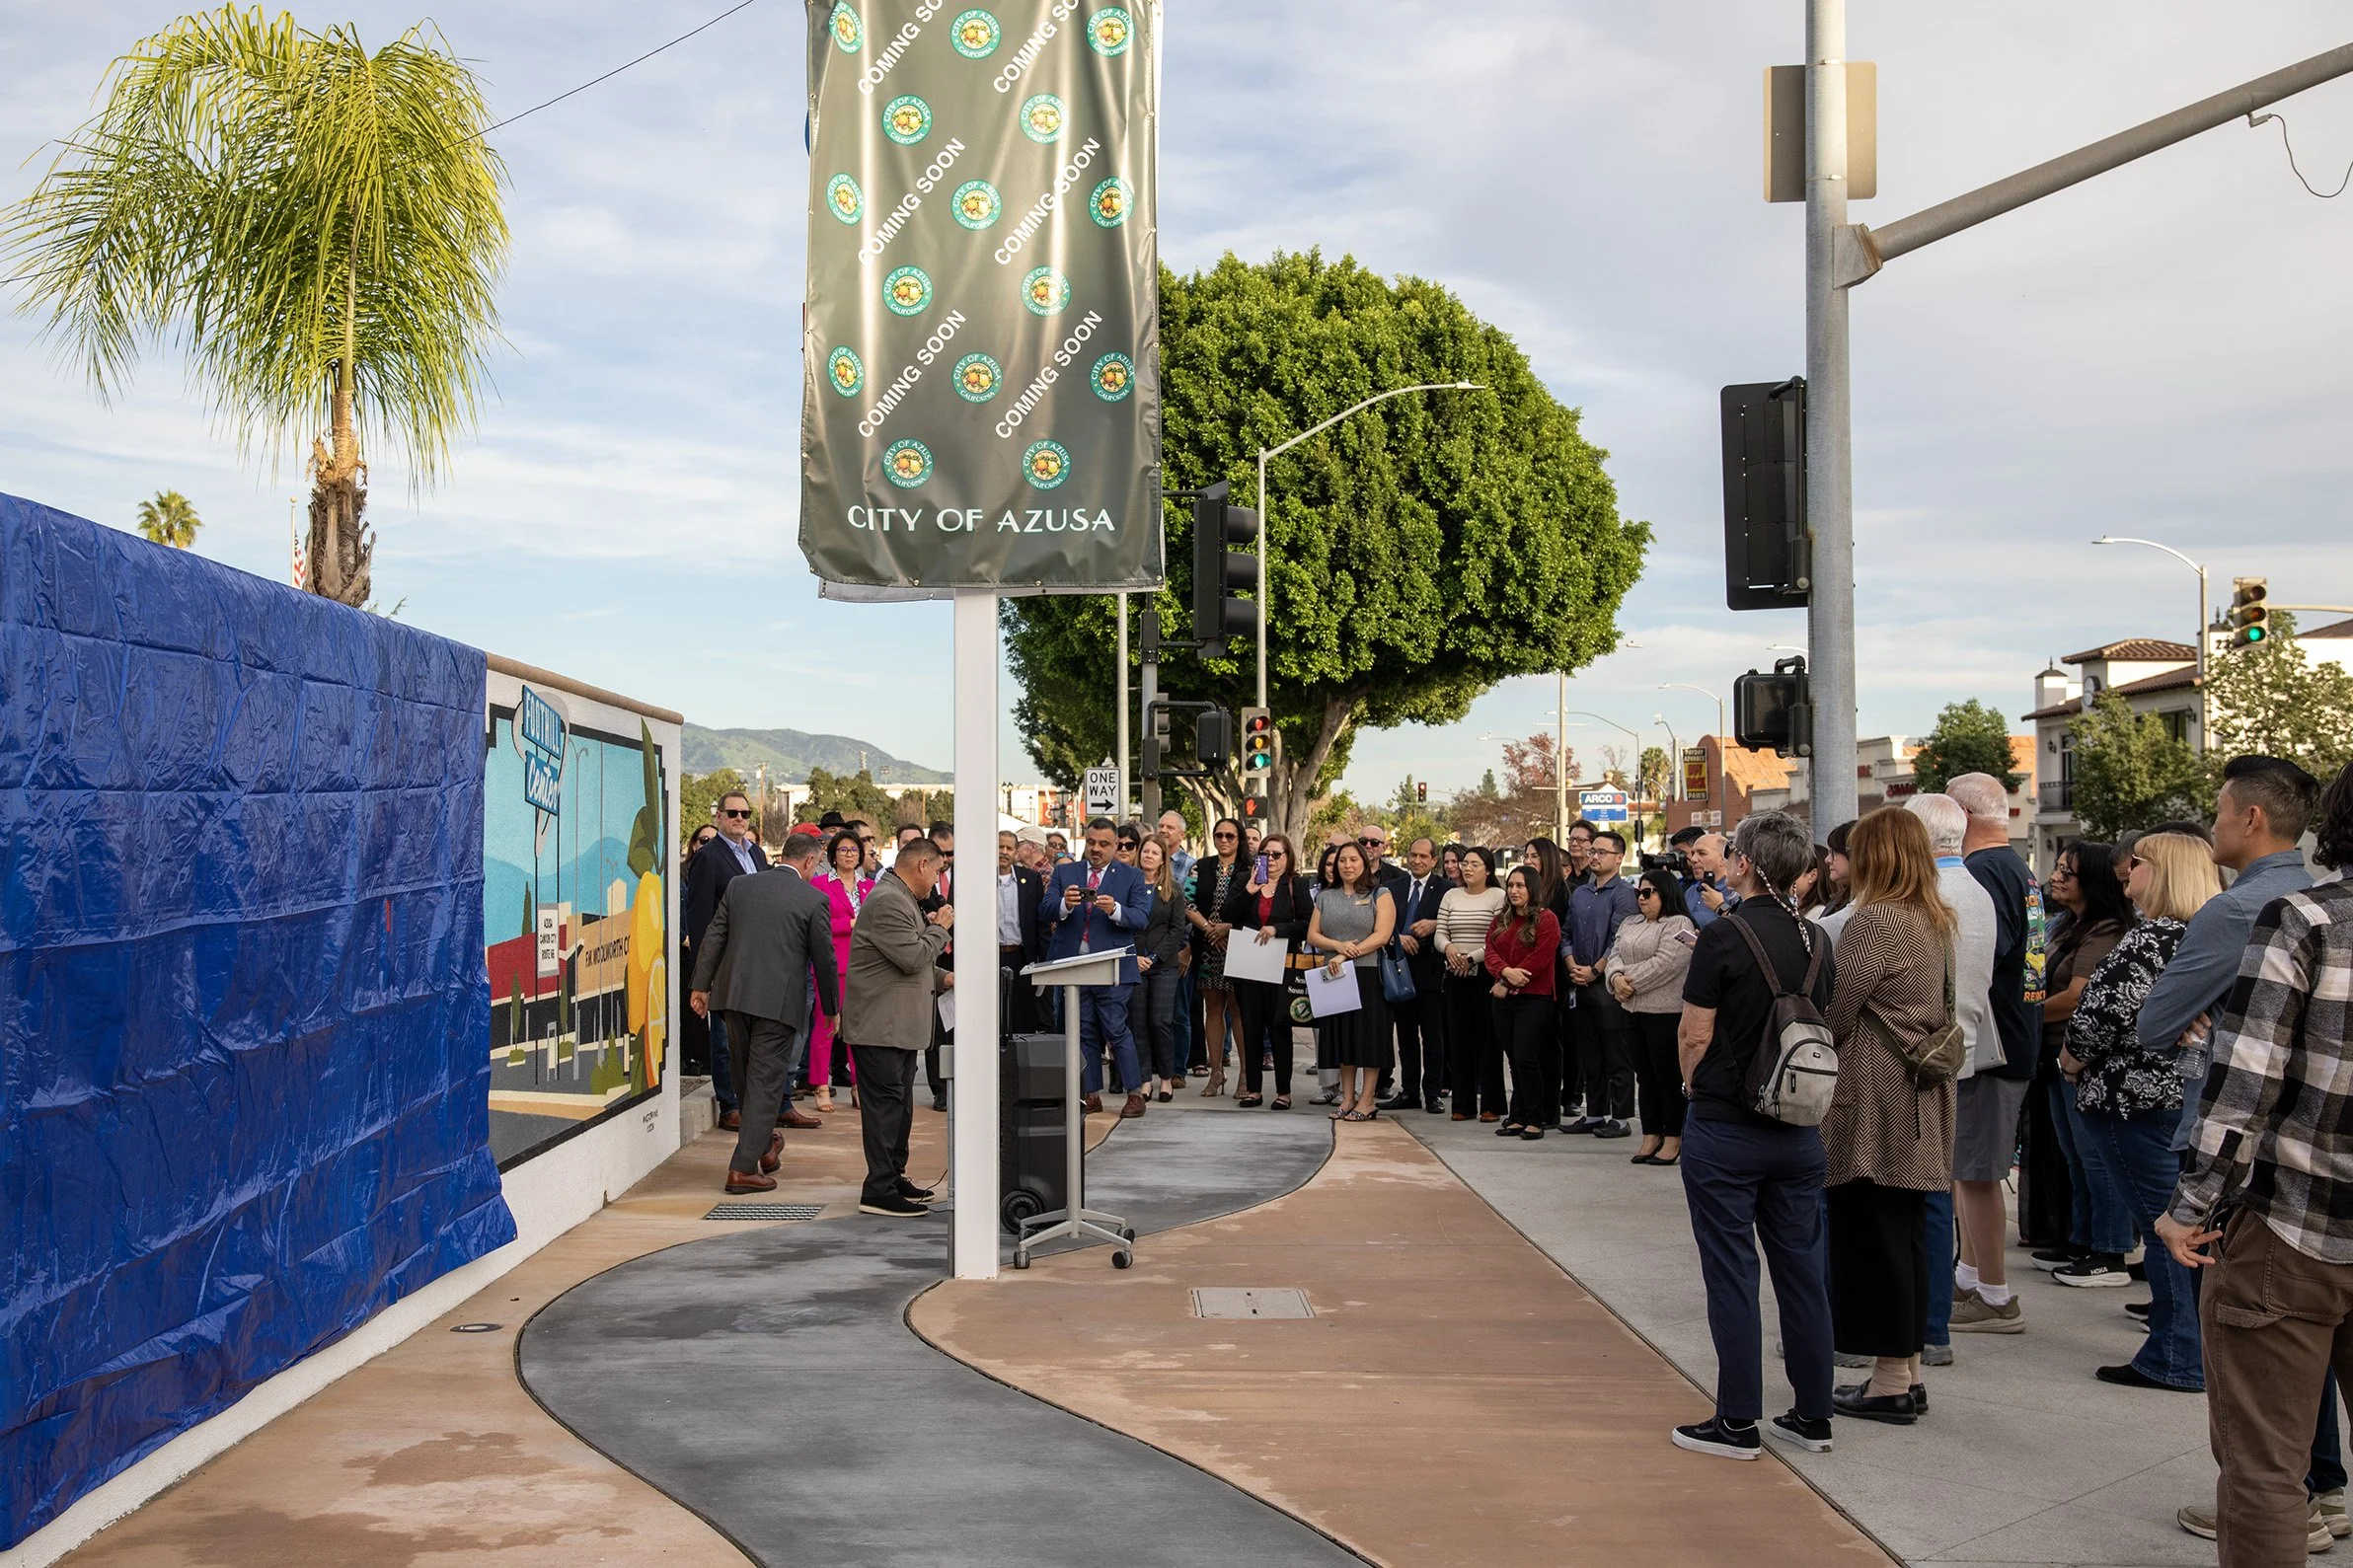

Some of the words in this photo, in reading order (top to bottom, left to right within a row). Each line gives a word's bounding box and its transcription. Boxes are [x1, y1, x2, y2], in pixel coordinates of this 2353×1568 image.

[858, 22, 921, 96] COMING
[915, 0, 943, 22] SO
[993, 21, 1058, 93] COMING
[1052, 0, 1079, 21] SO
[858, 193, 922, 266] COMING
[916, 137, 966, 193] SOON
[994, 193, 1057, 265] COMING
[898, 267, 910, 275] OF
[967, 354, 979, 363] OF
[1104, 353, 1115, 362] OF
[858, 366, 922, 438] COMING
[916, 309, 966, 366] SOON
[995, 367, 1060, 438] COMING
[1054, 310, 1103, 367] SOON
[898, 440, 910, 448] OF
[848, 505, 922, 531] CITY
[937, 508, 984, 532] OF
[997, 508, 1115, 532] AZUSA
[526, 691, 560, 754] FOOTHILL
[529, 757, 558, 811] Center
[1089, 785, 1116, 796] WAY
[1090, 772, 1116, 783] ONE
[1585, 794, 1613, 804] ARCO
[2090, 1267, 2109, 1275] HOKA
